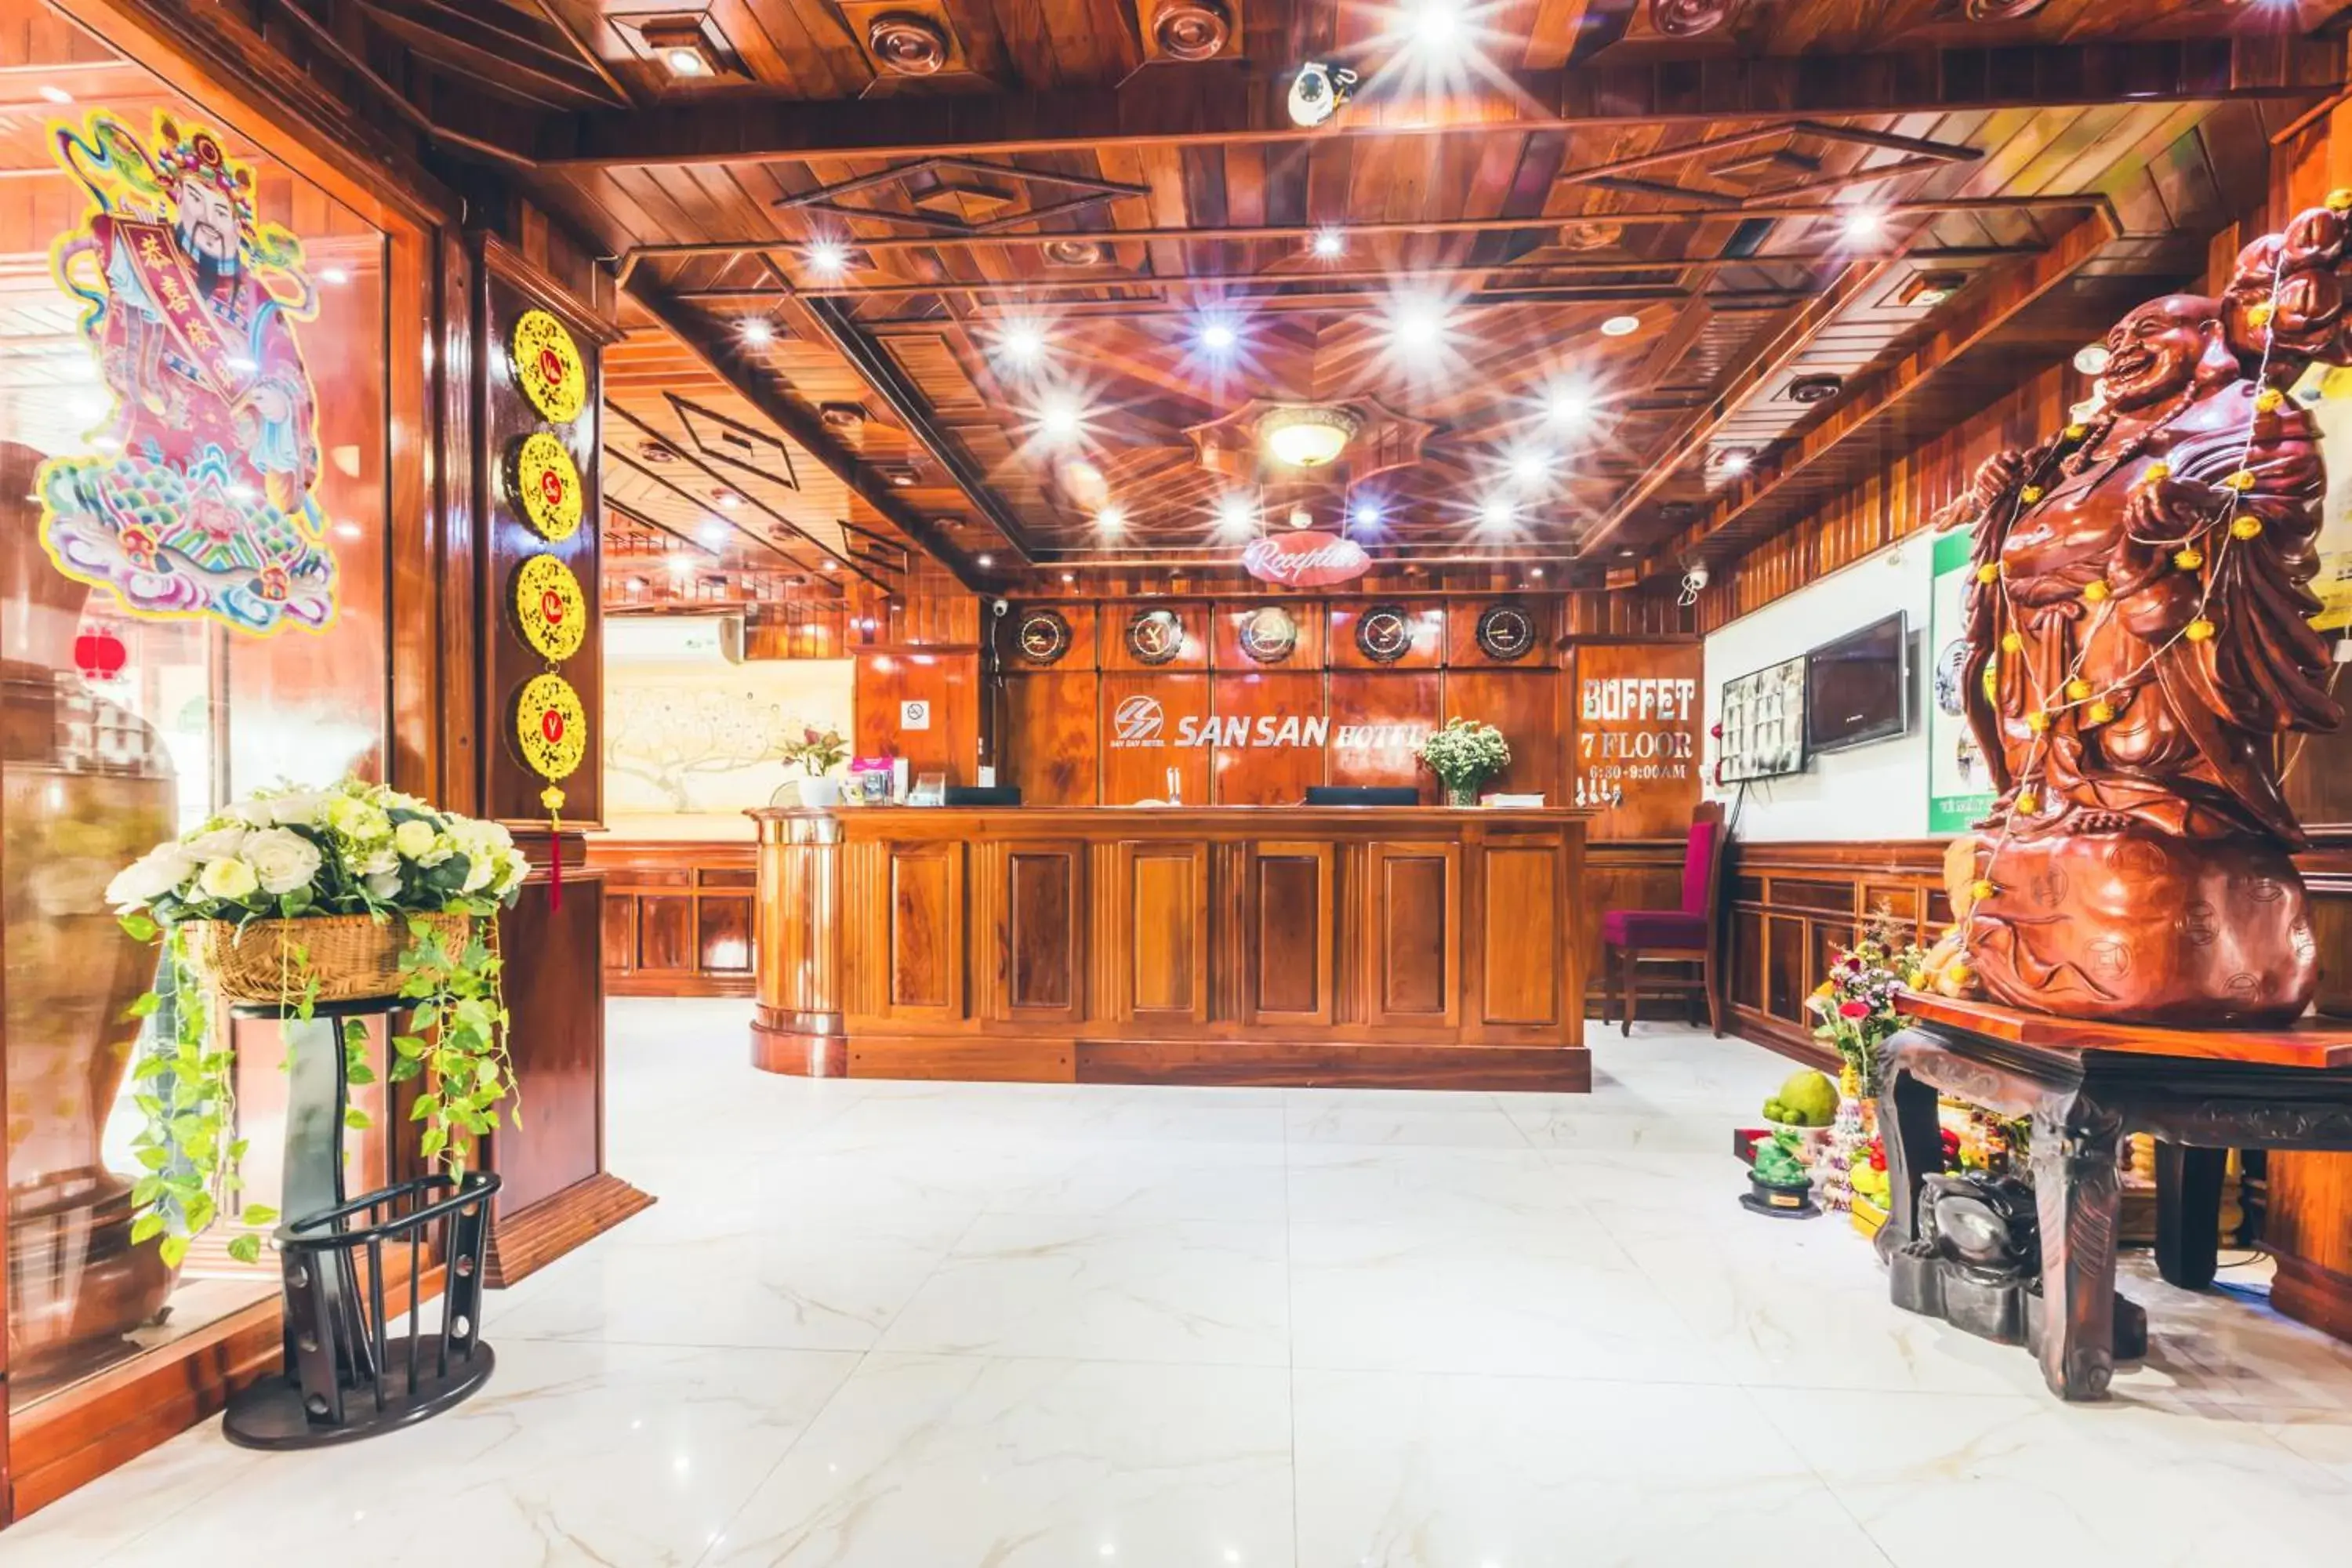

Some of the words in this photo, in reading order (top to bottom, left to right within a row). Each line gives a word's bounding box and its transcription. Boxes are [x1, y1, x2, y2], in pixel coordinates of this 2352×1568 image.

[1583, 678, 1695, 720] BUFFET
[1174, 716, 1251, 746] SAN
[1252, 716, 1330, 746] SAN
[1333, 725, 1424, 748] HOTEL
[1581, 732, 1595, 758] 7
[1602, 731, 1693, 758] FLOOR
